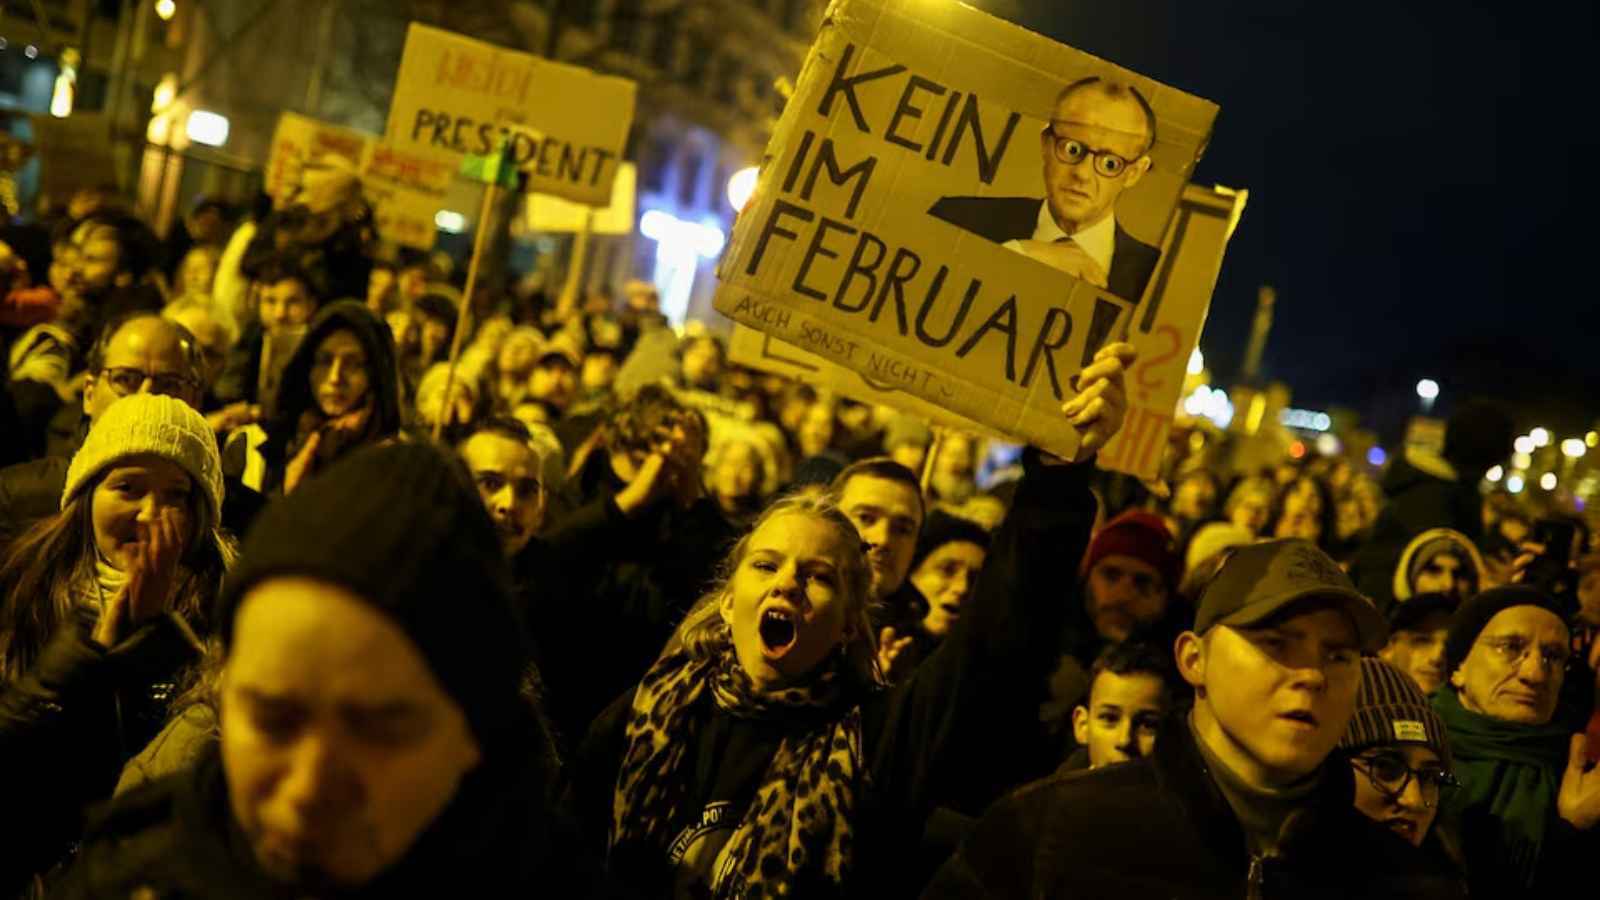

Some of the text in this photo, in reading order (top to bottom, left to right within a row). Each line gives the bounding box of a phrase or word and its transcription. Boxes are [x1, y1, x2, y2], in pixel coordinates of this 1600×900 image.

[818, 44, 1021, 185] KEIN
[781, 131, 877, 220] IM
[734, 295, 792, 329] AUCH
[801, 319, 860, 354] SONST
[866, 352, 937, 389] NICHT
[746, 199, 1123, 401] FEBRUAR!
